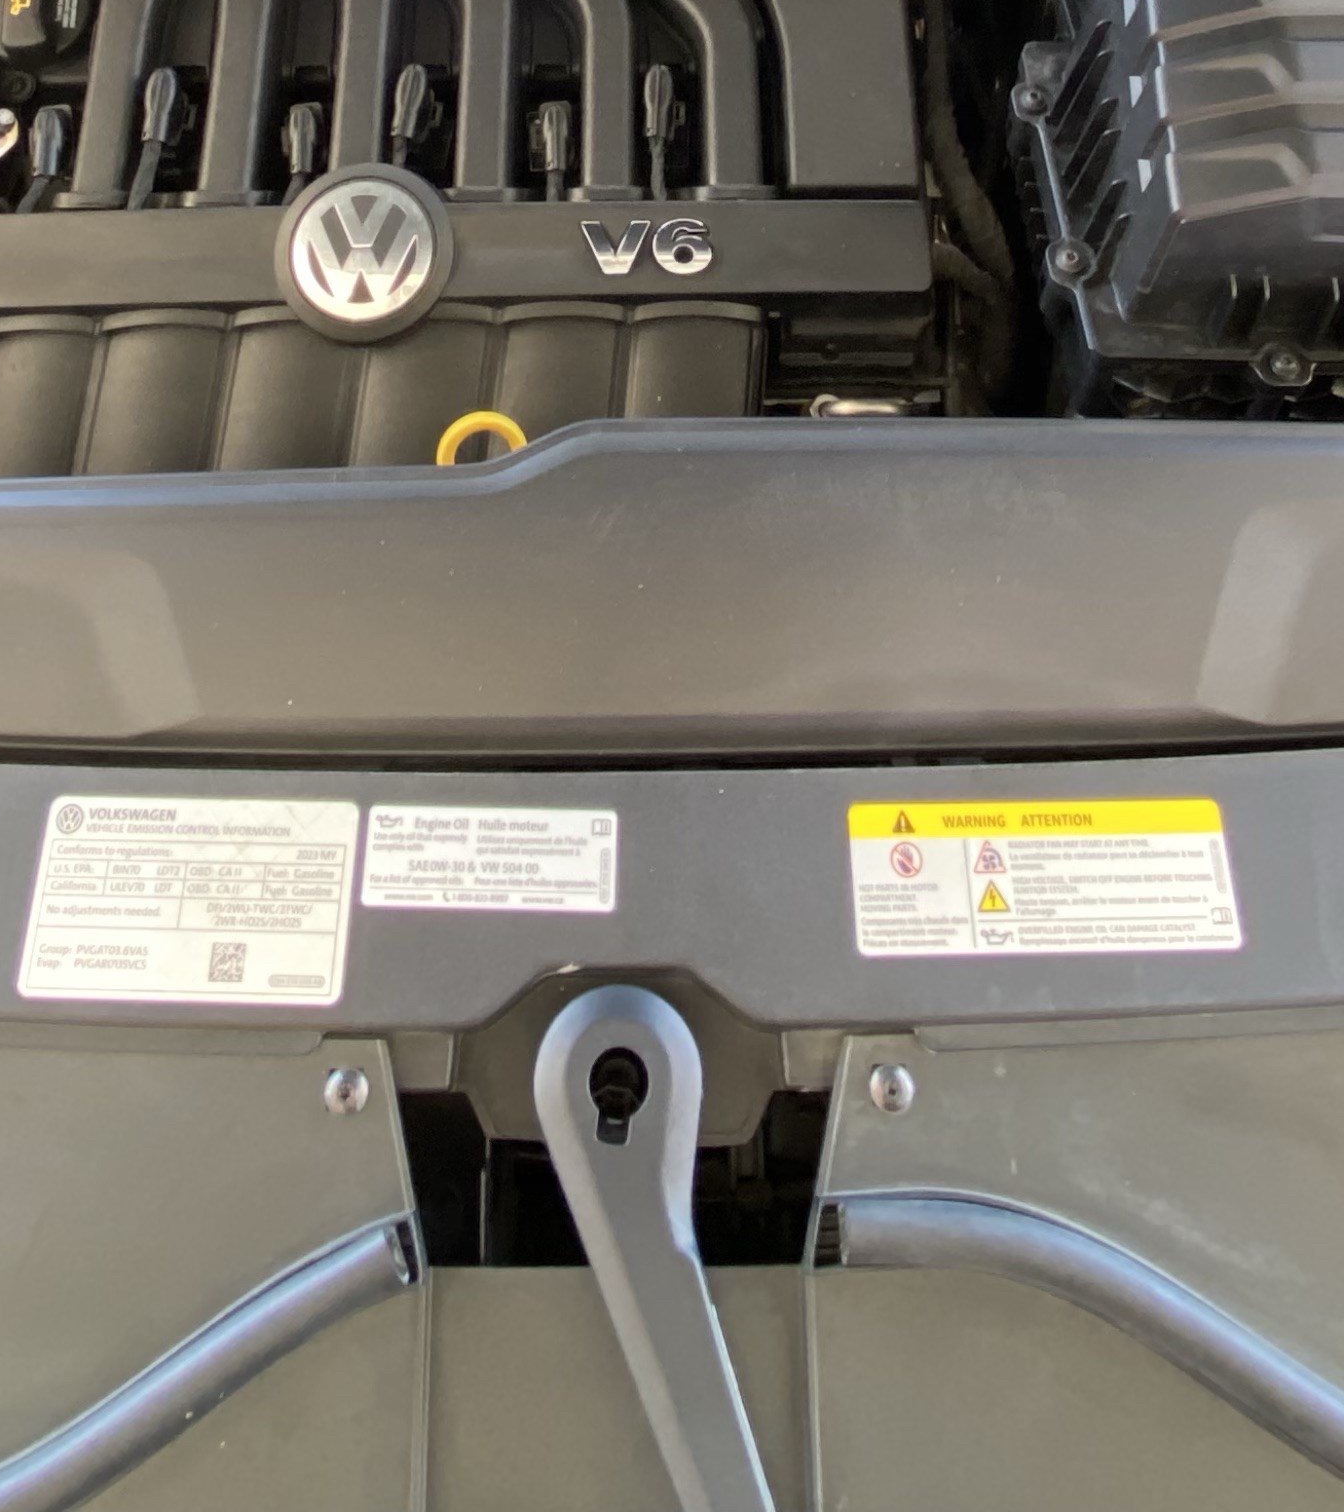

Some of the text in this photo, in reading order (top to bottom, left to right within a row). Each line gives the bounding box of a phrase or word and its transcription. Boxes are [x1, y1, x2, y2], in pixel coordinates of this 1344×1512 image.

[580, 218, 714, 276] V6
[88, 808, 178, 822] VOLKSWAGEN
[942, 813, 1093, 828] WARNING ATTENTION
[86, 824, 290, 837] VEHICLE EMISSION CONTROL INFORMATION
[414, 818, 470, 832] Engine Oil
[478, 819, 550, 832] Huile moteur
[56, 844, 104, 854] Conforms
[104, 846, 115, 854] to
[296, 850, 337, 860] 2023 MY
[408, 859, 429, 872] SAE
[430, 860, 464, 872] 0W-30
[467, 860, 476, 873] &
[481, 862, 500, 874] VW
[502, 862, 522, 874] 504
[294, 868, 334, 880] Gasoline
[291, 885, 333, 896] Gasoline
[46, 904, 60, 914] No
[61, 904, 122, 916] adjustments
